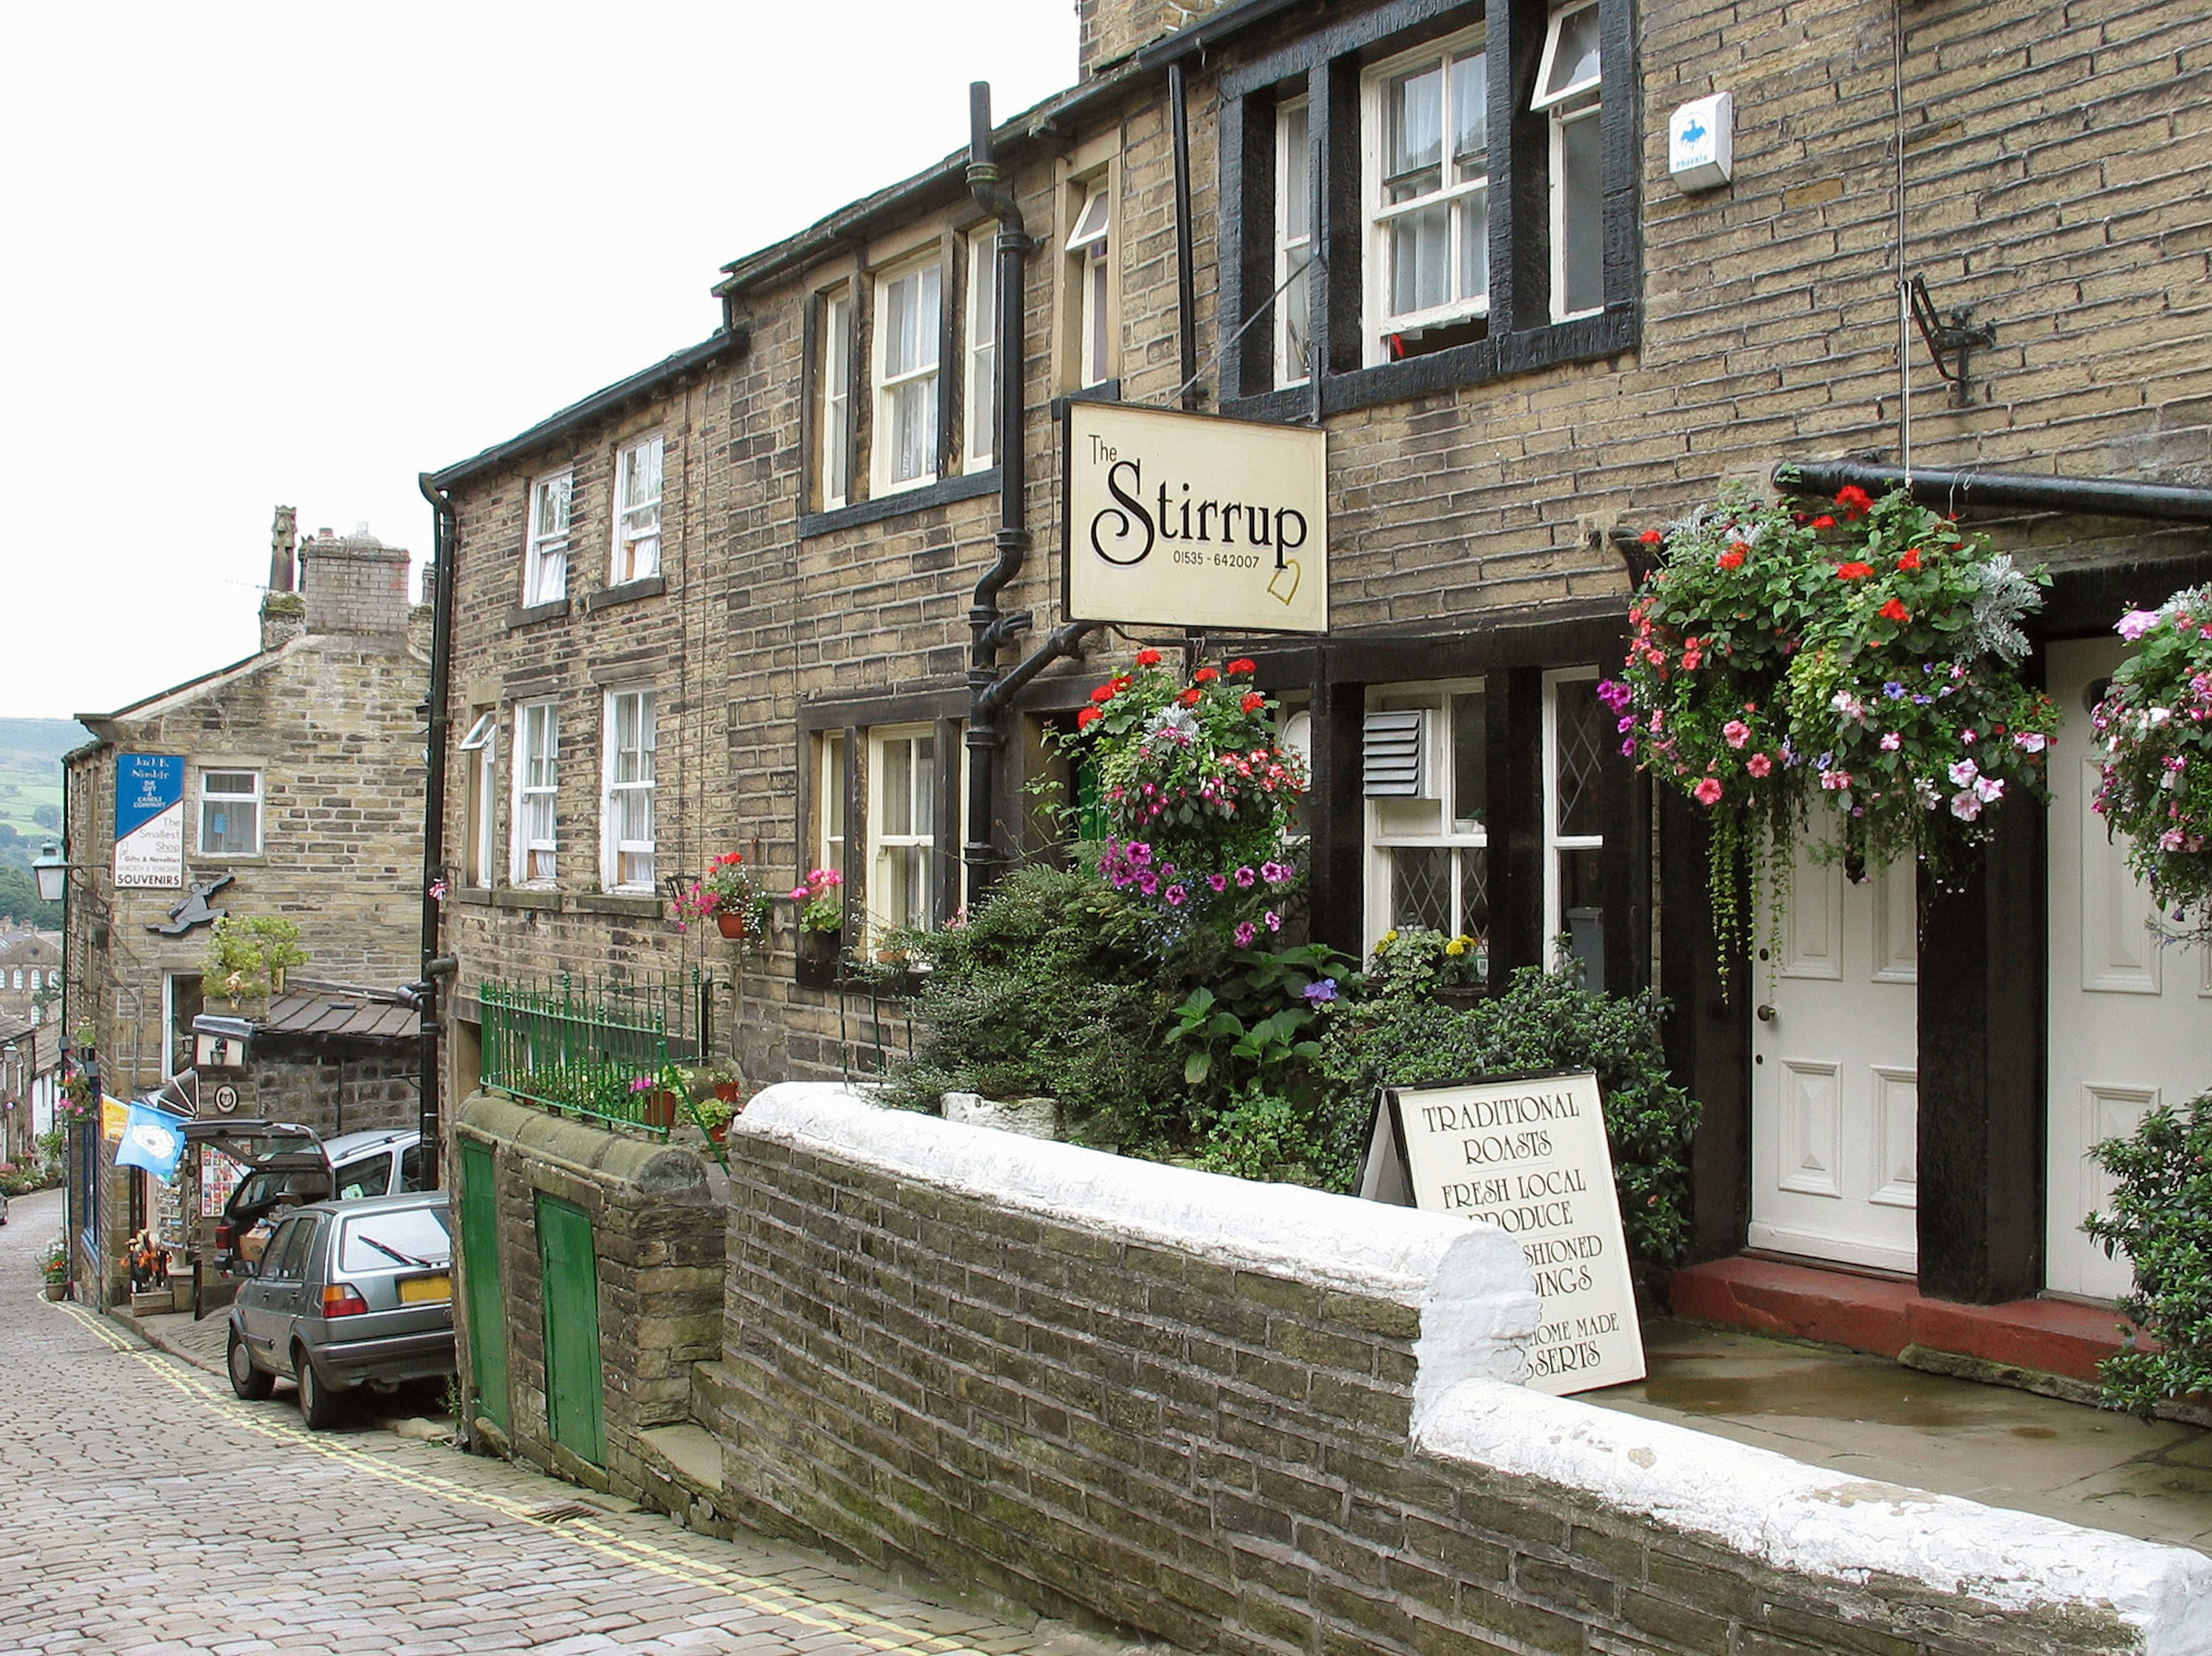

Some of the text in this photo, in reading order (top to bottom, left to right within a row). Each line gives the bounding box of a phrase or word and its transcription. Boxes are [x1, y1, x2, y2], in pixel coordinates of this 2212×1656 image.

[1088, 434, 1118, 464] The
[1090, 458, 1308, 569] Stirrup
[1173, 550, 1203, 565] 01535
[1214, 552, 1259, 569] 642007
[139, 830, 180, 838] Smallest
[164, 818, 180, 827] The
[156, 842, 180, 852] Shop
[118, 874, 179, 885] SOUVENIRS
[1422, 1092, 1580, 1132] TRADITIONAL
[1462, 1130, 1552, 1165] ROASTS
[1441, 1168, 1586, 1209] FRESH LOCAL
[1468, 1200, 1573, 1232] ODUCE
[1576, 1313, 1620, 1343] MADE
